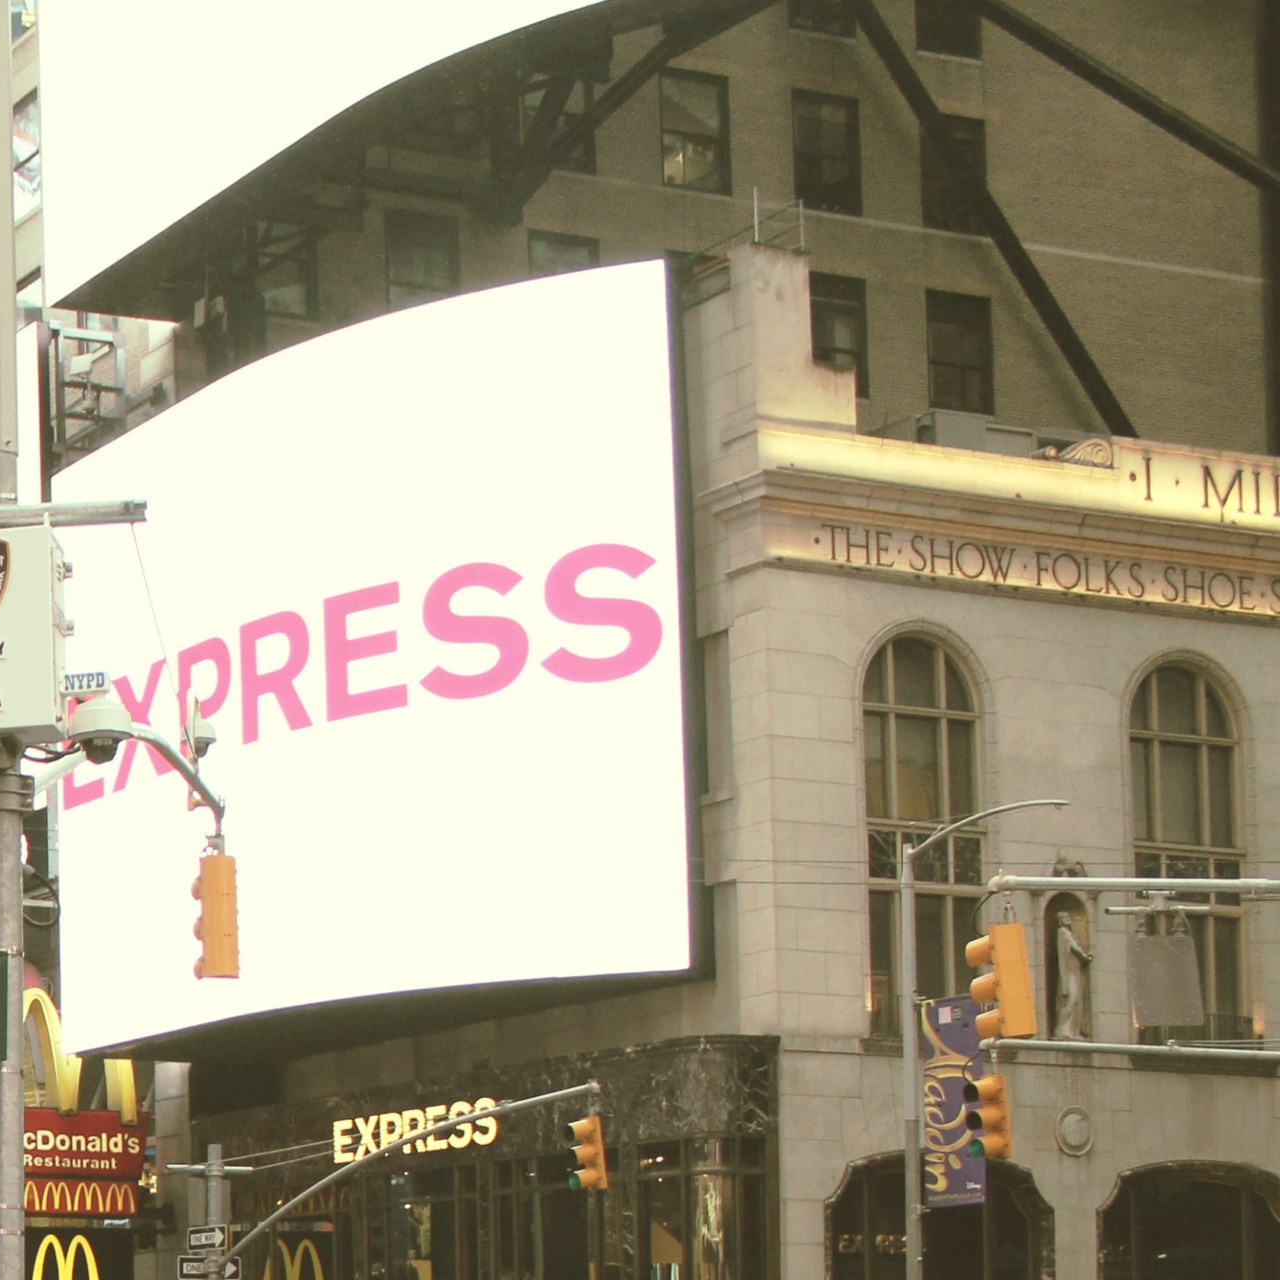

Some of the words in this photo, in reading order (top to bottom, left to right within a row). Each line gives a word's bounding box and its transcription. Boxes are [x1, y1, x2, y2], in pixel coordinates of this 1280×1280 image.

[821, 524, 894, 569] THE
[908, 534, 1016, 585] SHOW
[1035, 550, 1145, 599] FOLKS
[1160, 565, 1256, 612] SHOE
[64, 672, 105, 691] NYPD
[332, 1097, 498, 1164] EXPRESS
[23, 1130, 140, 1154] cDonald's
[23, 1155, 117, 1170] Restaurant
[192, 1233, 203, 1245] ONE
[185, 1263, 202, 1273] ONE
